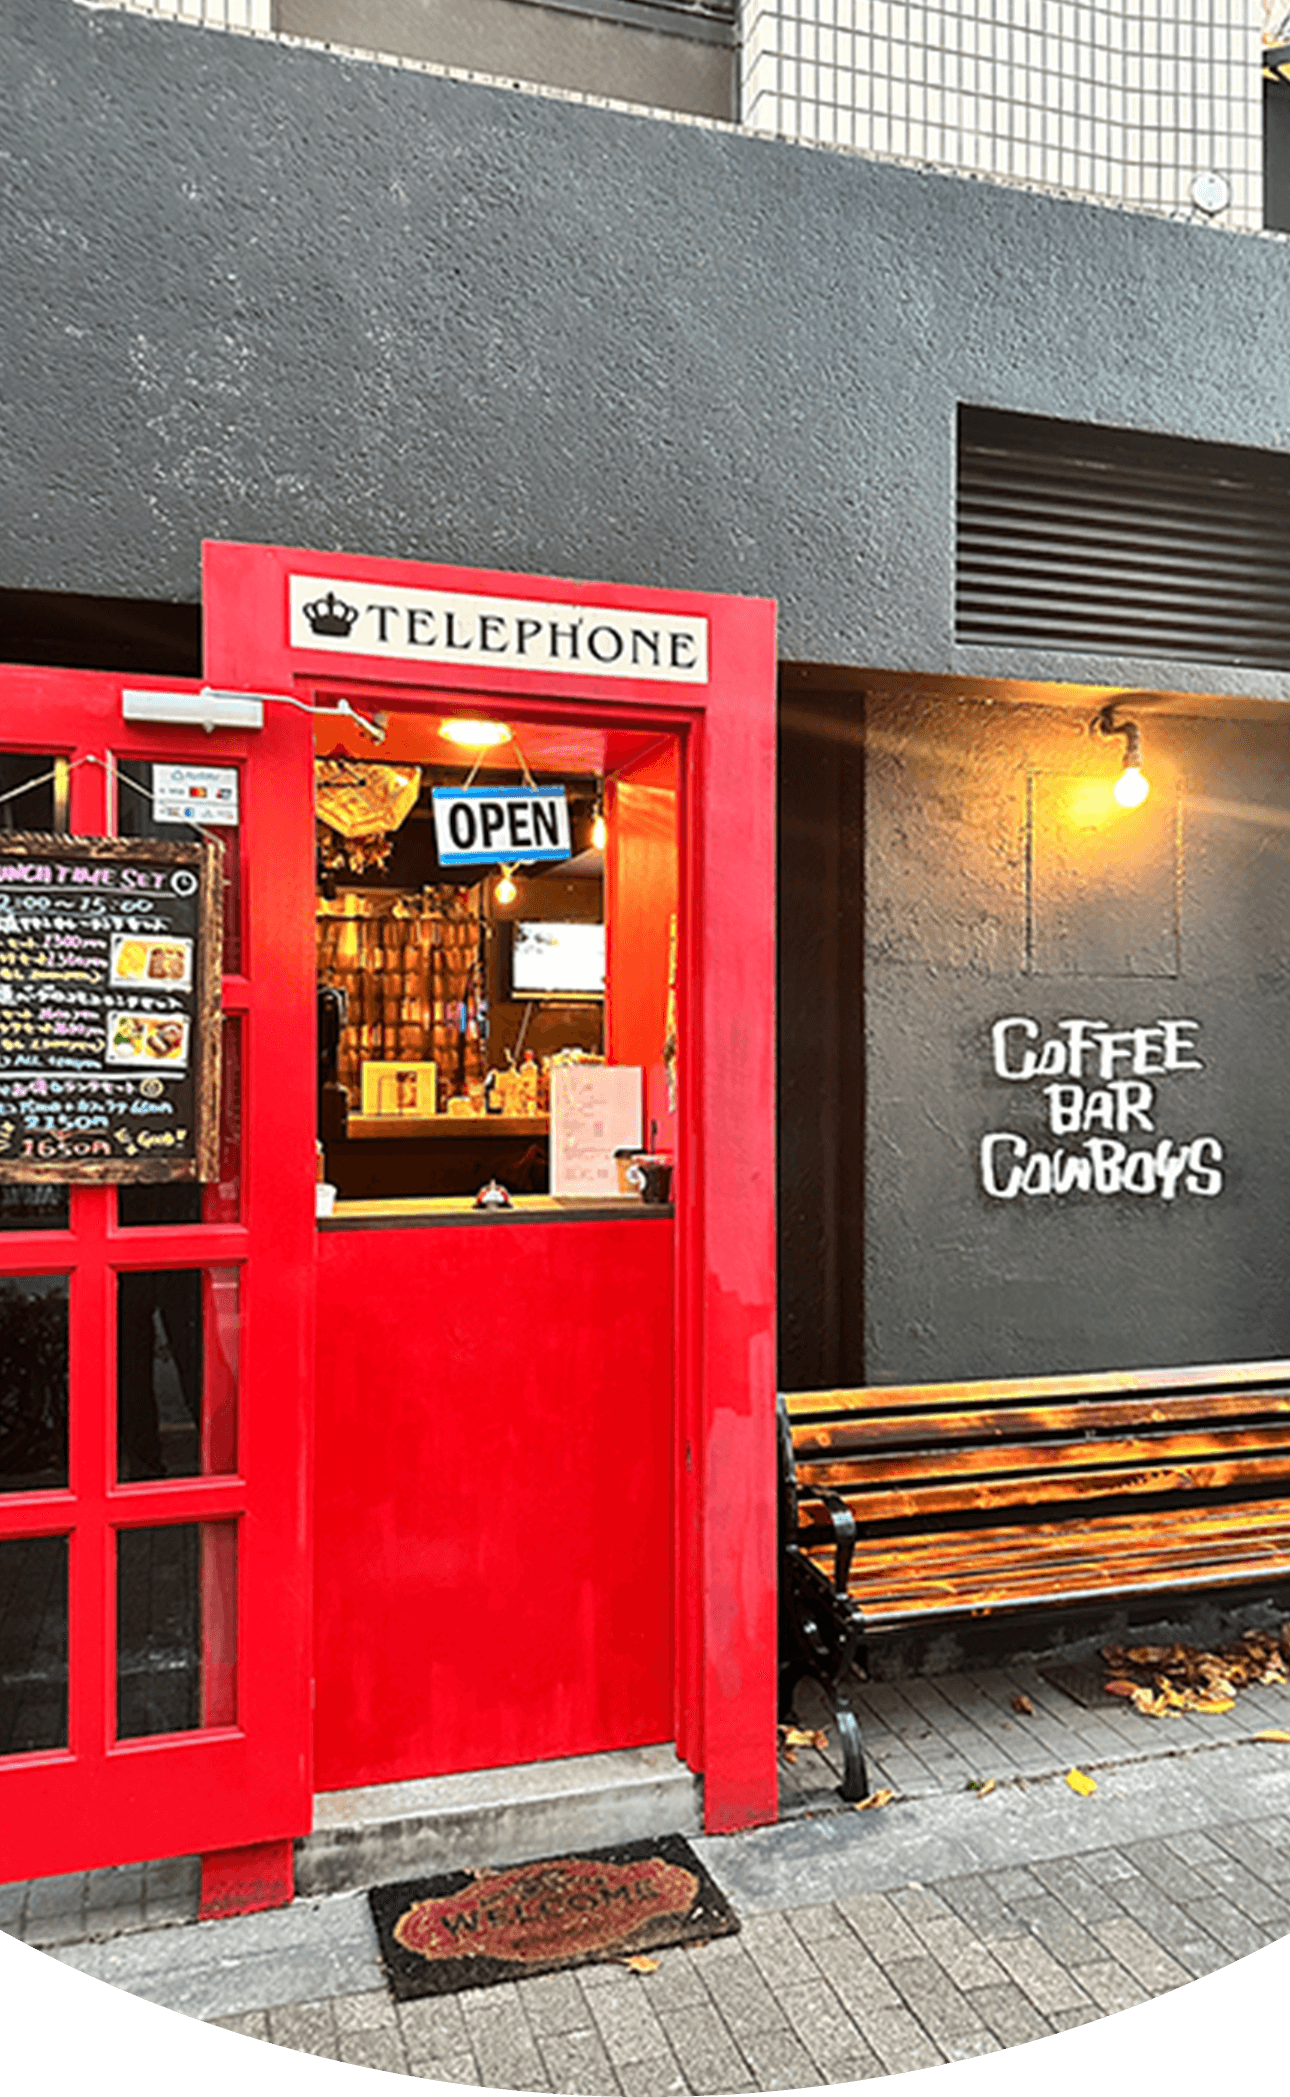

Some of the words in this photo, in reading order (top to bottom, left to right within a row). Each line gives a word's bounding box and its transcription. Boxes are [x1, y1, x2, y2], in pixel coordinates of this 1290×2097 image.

[366, 605, 699, 670] TELEPHONE
[448, 800, 560, 849] OPEN
[120, 868, 166, 889] SET
[992, 1017, 1203, 1080] COFFEE
[1043, 1081, 1154, 1135] BAR
[981, 1132, 1222, 1200] COWBOYS
[440, 1877, 662, 1935] WELCOME
